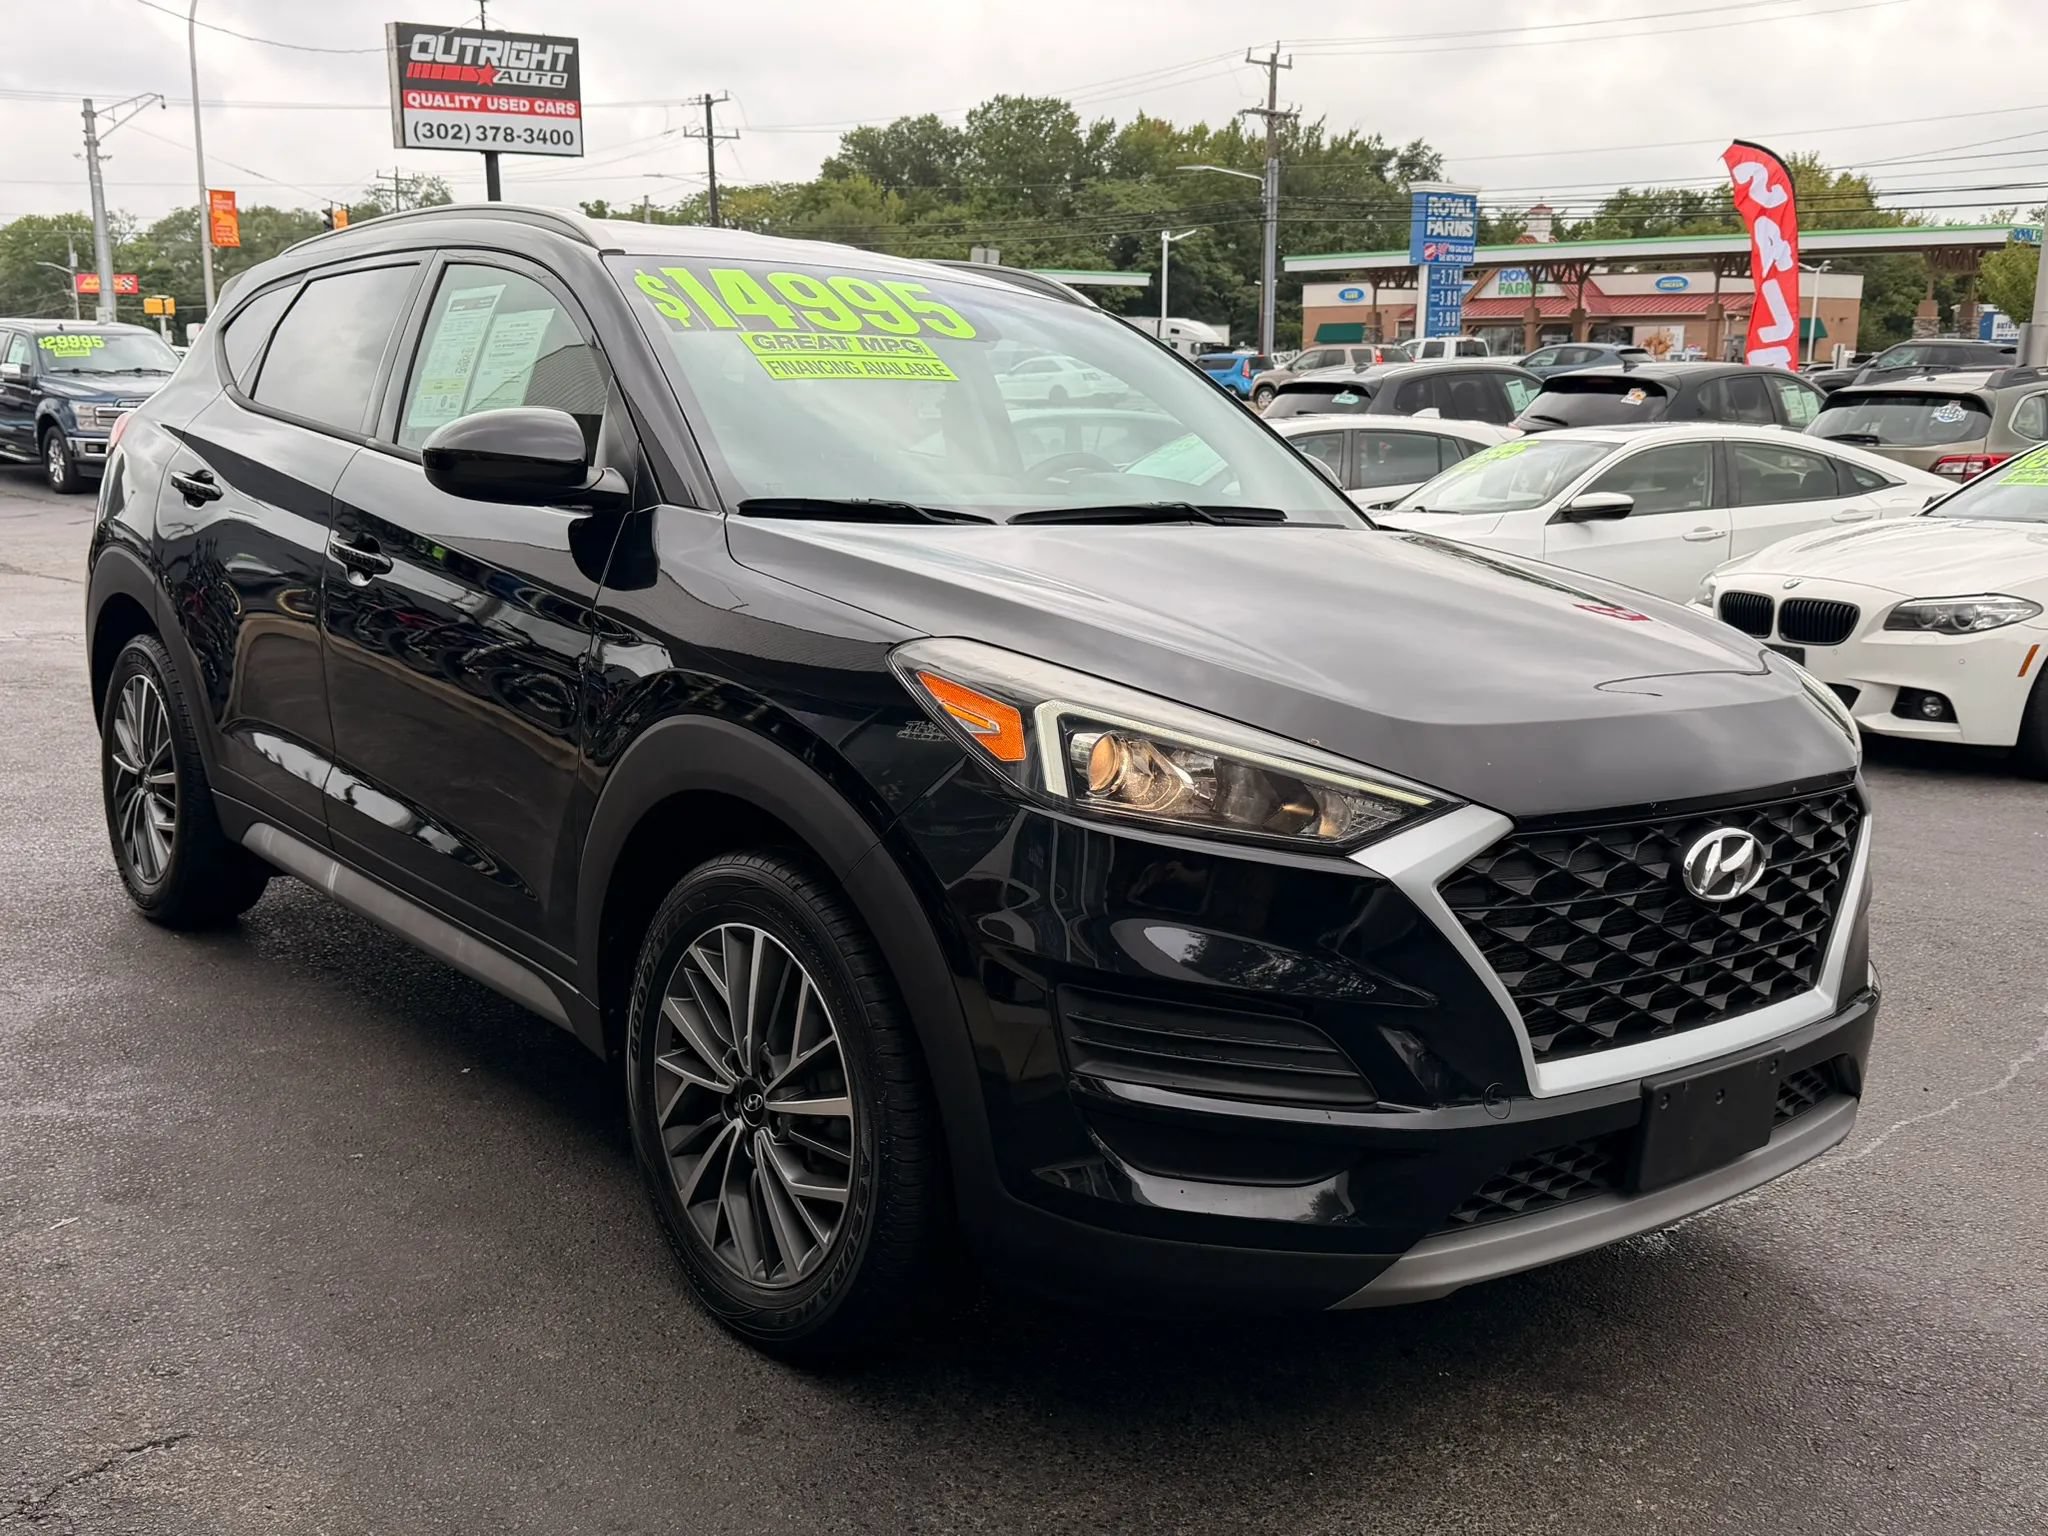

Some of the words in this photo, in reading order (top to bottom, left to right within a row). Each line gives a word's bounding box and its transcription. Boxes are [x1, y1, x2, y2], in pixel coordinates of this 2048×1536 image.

[409, 33, 574, 72] OUTRIGHT
[498, 70, 566, 87] AUTO
[407, 93, 482, 110] QUALITY
[487, 97, 530, 113] USED
[534, 100, 576, 115] CARS
[476, 125, 574, 146] 378-3400
[1427, 196, 1474, 217] ROYAL
[1426, 217, 1474, 238] FARMS
[1499, 269, 1534, 283] ROY
[633, 267, 976, 339] $14995
[38, 335, 105, 349] $29995
[751, 334, 851, 351] GREAT
[857, 337, 926, 354] MPG
[765, 360, 864, 376] FINANCING
[861, 361, 951, 377] AVAILABLE
